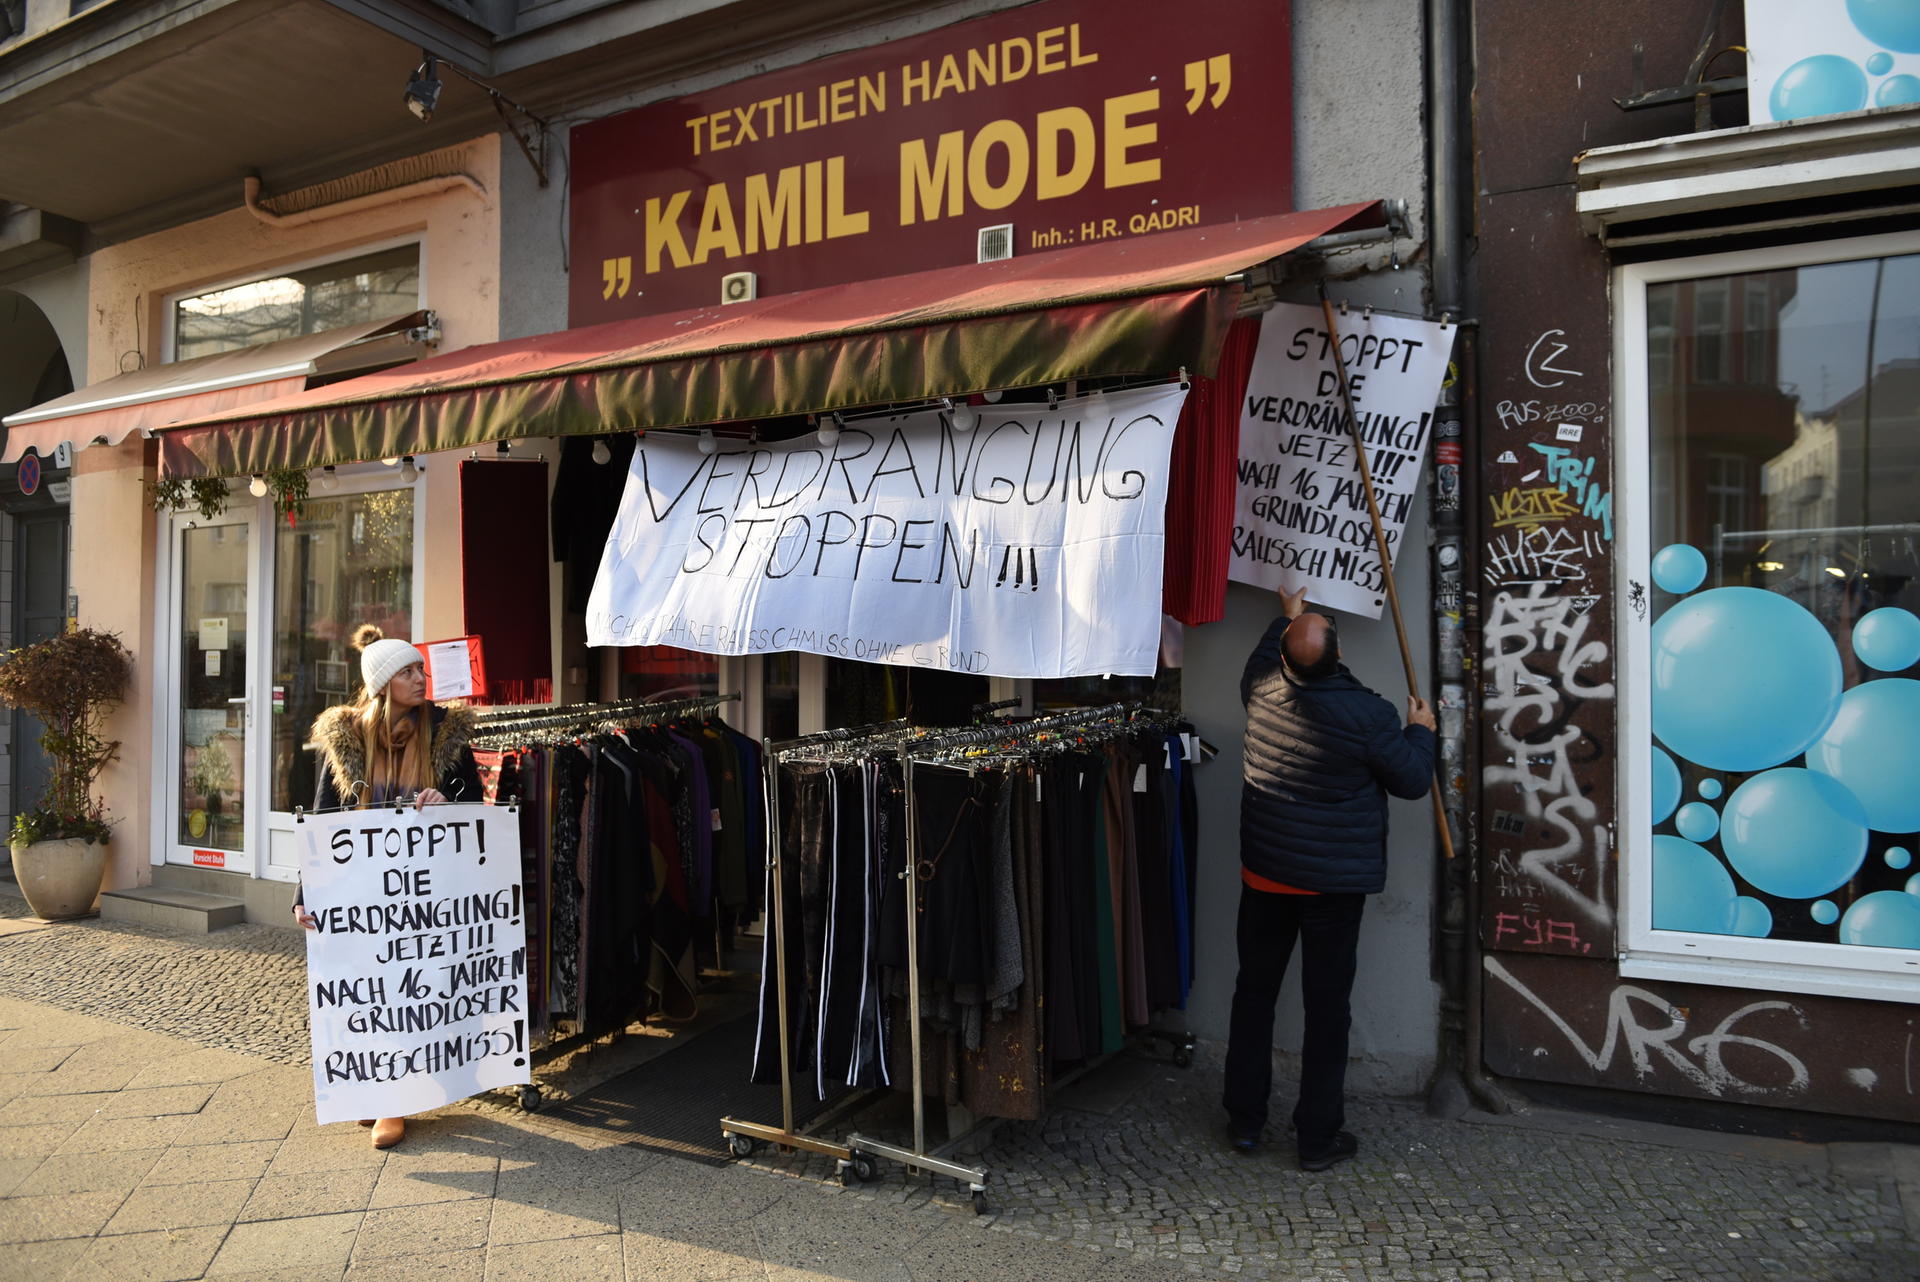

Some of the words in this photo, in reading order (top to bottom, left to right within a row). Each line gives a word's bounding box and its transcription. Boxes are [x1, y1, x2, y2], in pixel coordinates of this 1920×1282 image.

[686, 71, 887, 156] TEXTILIEN
[902, 23, 1099, 106] HANDEL
[1081, 219, 1123, 240] H.R.
[1129, 205, 1201, 235] QADRI
[1558, 427, 1580, 438] IRRE
[640, 412, 1165, 523] VERDRÄNGUNG
[1236, 458, 1282, 490] NACH
[1289, 467, 1320, 501] 16
[330, 818, 487, 865] STOPPT!
[310, 884, 521, 935] VERDRÄNGUNG!
[316, 976, 387, 1009] NACH
[398, 967, 432, 1000] 16
[438, 946, 526, 1000] JAHREN
[347, 984, 520, 1035] GRUNDLOSER
[324, 1019, 526, 1085] RAUSSCHMISS!
